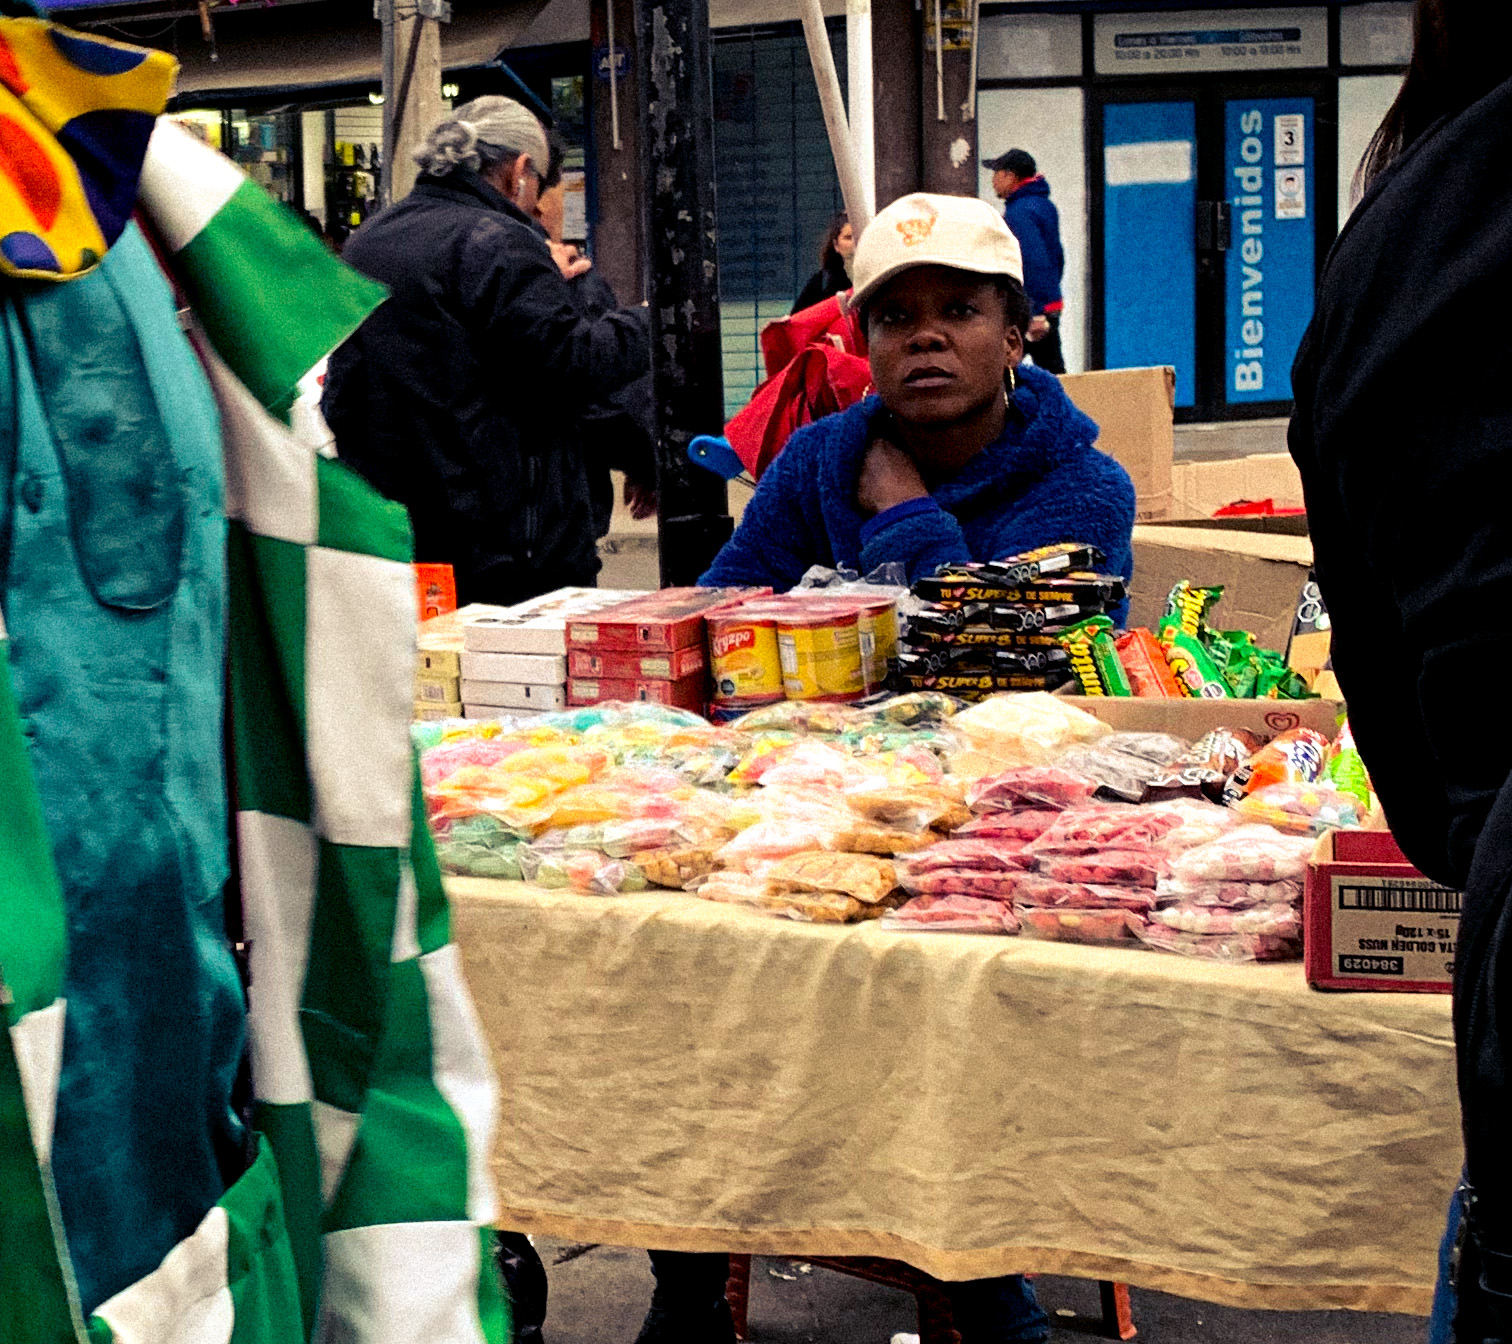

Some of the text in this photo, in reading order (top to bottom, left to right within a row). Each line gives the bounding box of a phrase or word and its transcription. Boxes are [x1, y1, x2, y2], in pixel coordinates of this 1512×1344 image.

[1284, 131, 1294, 146] 3
[1234, 109, 1263, 392] Bienvenidos
[1437, 928, 1451, 939] 15
[1358, 938, 1388, 951] NUSS
[1343, 956, 1399, 972] 384029
